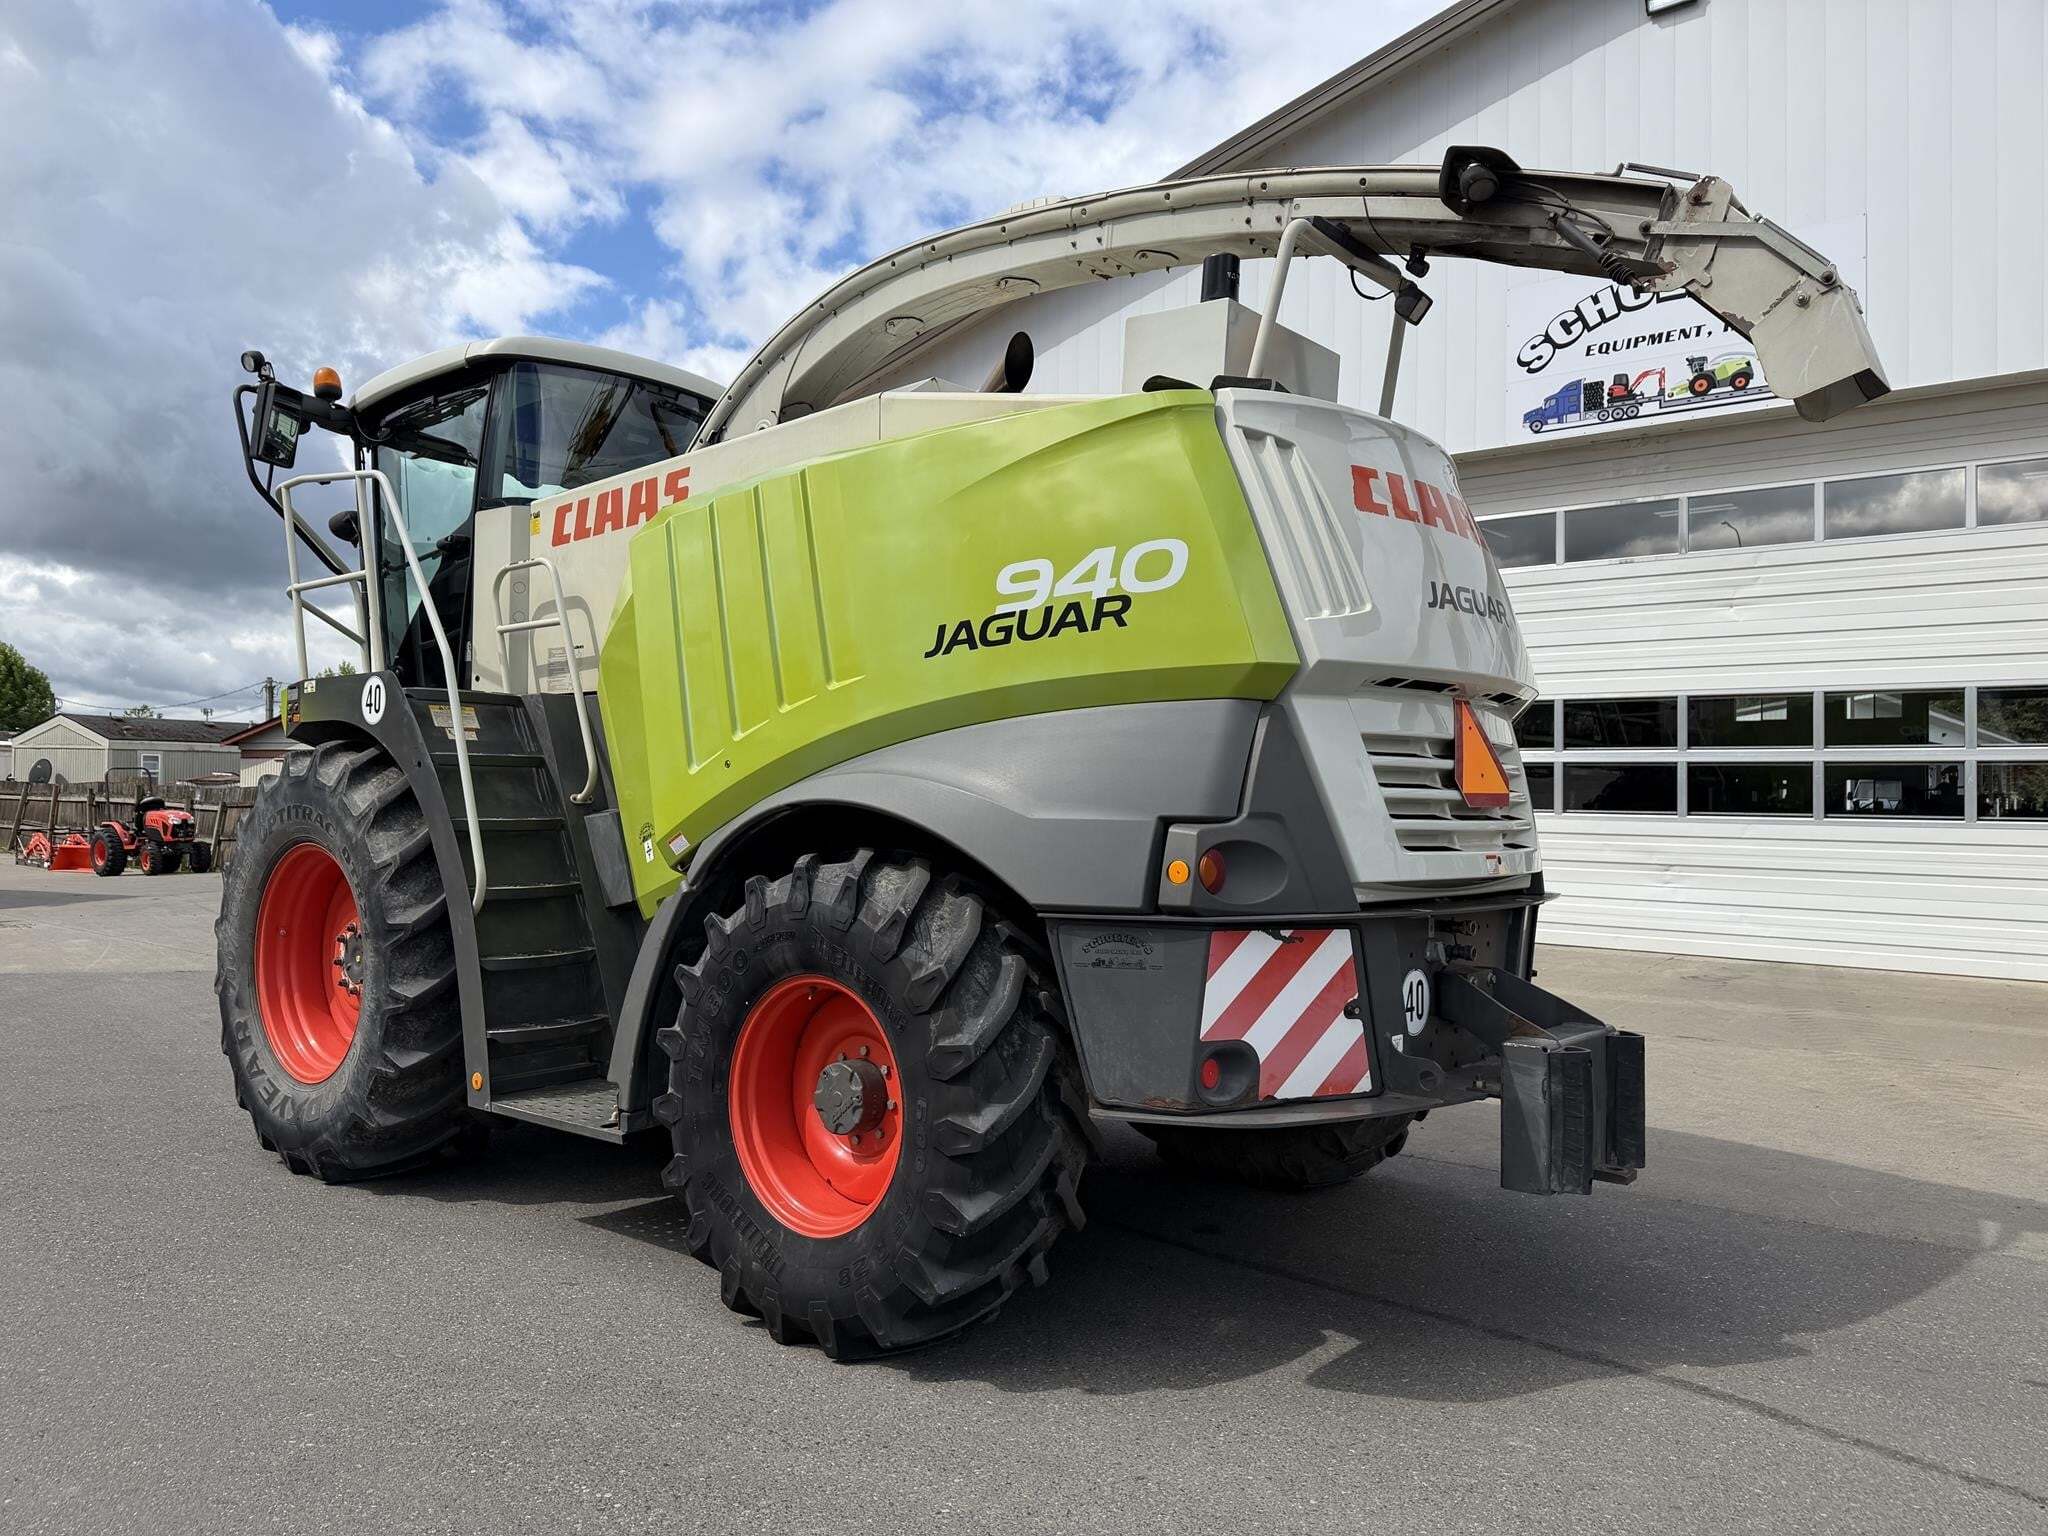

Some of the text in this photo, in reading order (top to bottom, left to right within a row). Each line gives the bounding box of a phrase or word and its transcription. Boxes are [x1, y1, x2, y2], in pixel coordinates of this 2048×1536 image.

[1584, 323, 1714, 358] EQUIPMENT,
[551, 466, 691, 548] CLAAS
[995, 538, 1189, 615] 940
[923, 594, 1133, 659] JAGUAR
[1427, 580, 1510, 628] JAGUAR
[365, 684, 381, 714] 40
[1404, 979, 1425, 1022] 40
